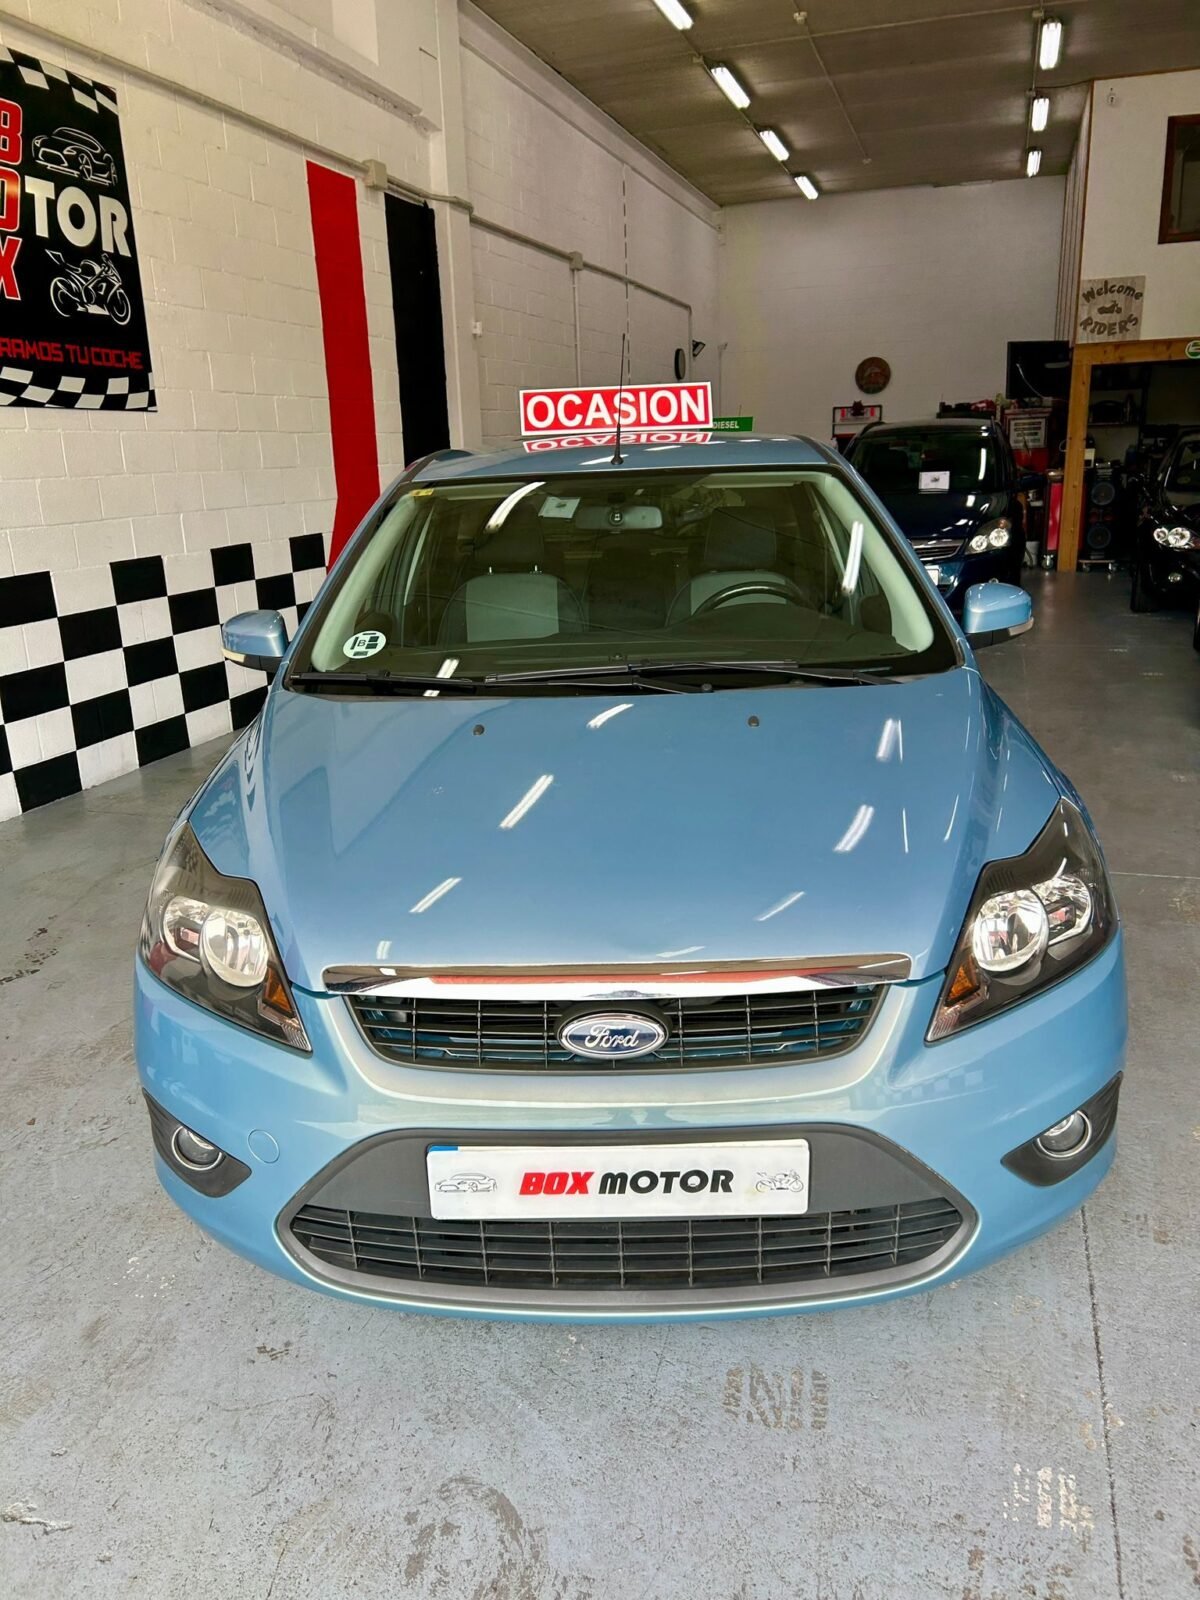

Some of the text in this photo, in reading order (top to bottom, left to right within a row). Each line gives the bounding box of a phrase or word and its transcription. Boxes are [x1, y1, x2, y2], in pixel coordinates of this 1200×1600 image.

[1082, 280, 1143, 303] Welcome
[1080, 314, 1138, 336] RIDERS
[65, 343, 90, 366] TU
[90, 346, 144, 370] COCHE
[526, 388, 706, 428] OCASION
[584, 1024, 640, 1049] Ford
[518, 1169, 734, 1195] BOX MOTOR
